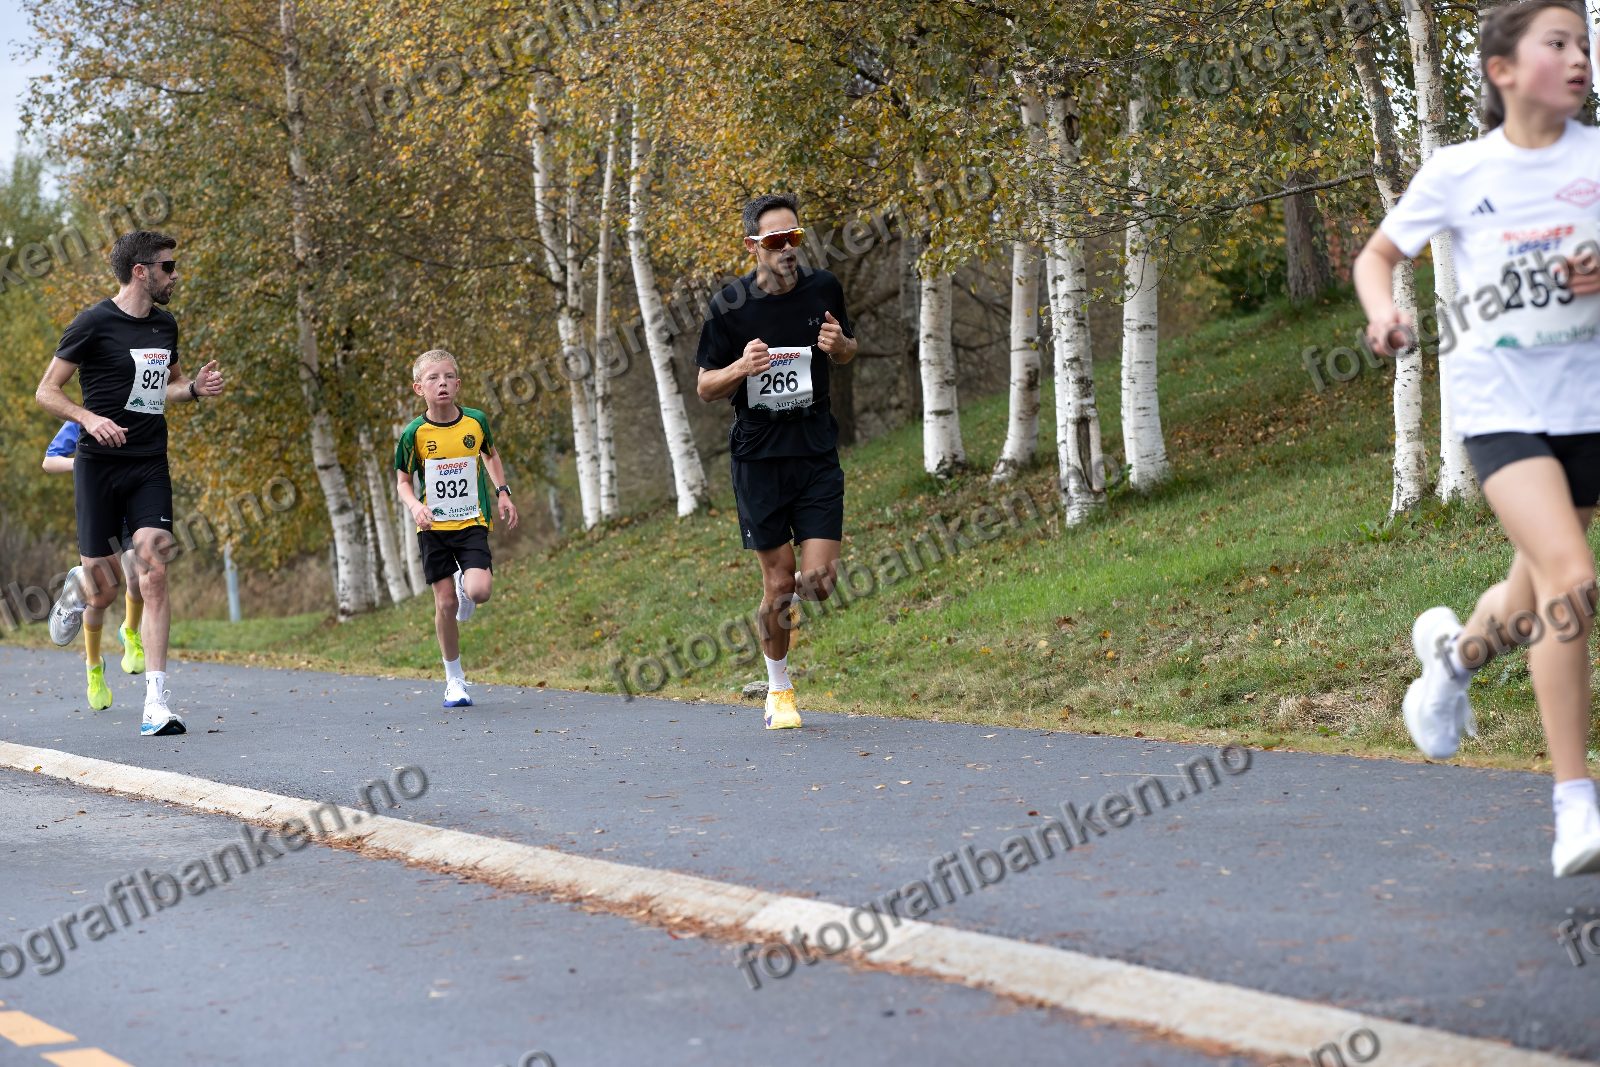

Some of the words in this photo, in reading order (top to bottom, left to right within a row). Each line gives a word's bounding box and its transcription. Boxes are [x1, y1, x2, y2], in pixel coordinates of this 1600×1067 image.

[1500, 269, 1576, 310] 259
[769, 352, 800, 361] ORGES
[770, 359, 794, 368] ØPET
[141, 369, 166, 390] 921
[760, 370, 799, 395] 266
[436, 461, 468, 471] NORGES
[439, 467, 463, 476] LØPET
[435, 478, 469, 499] 932
